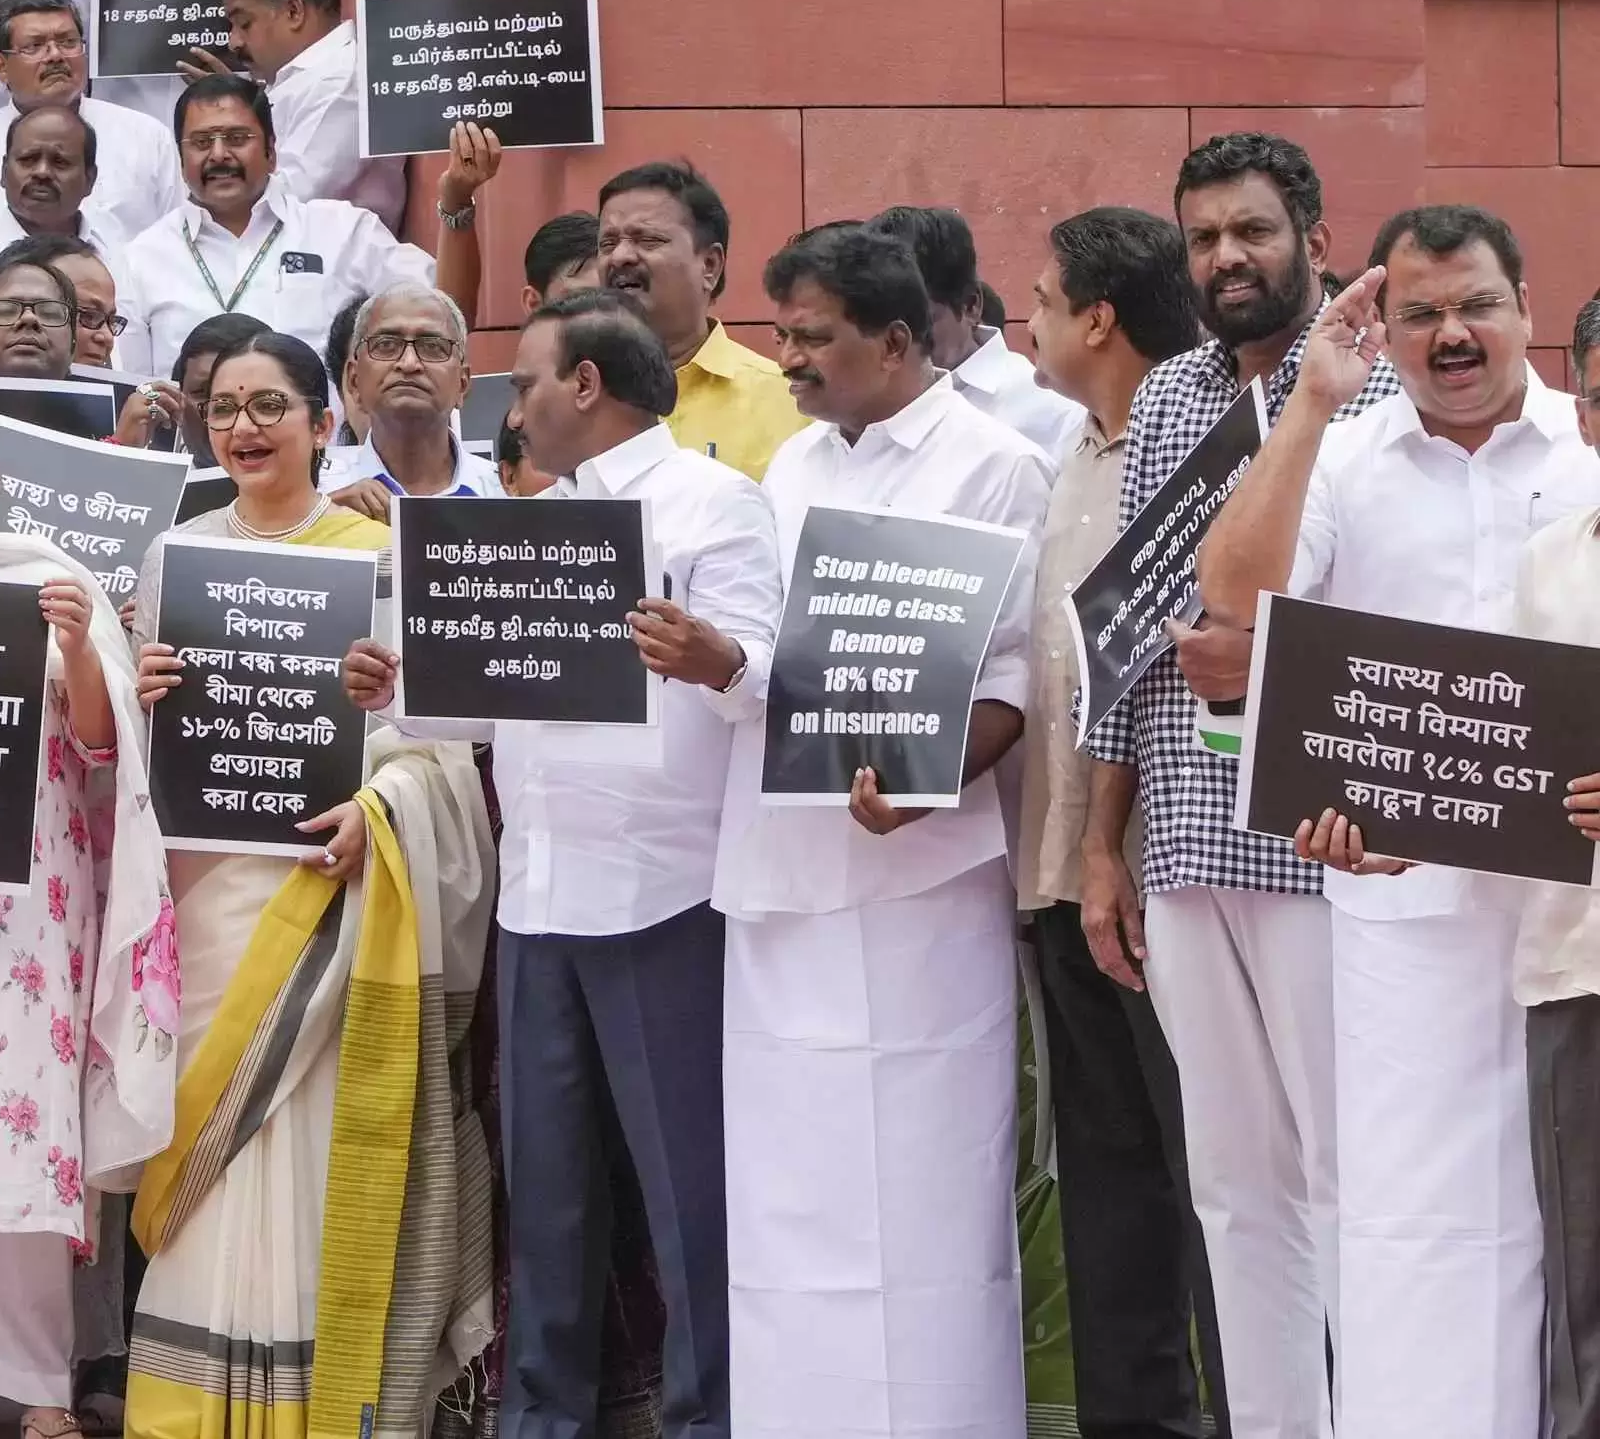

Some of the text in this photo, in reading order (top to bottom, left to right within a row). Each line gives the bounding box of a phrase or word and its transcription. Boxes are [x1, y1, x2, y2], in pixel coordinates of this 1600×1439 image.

[389, 11, 563, 41] மருத்துவம் மற்றும்
[391, 39, 562, 67] உயிர்க்காப்பீட்டில்
[371, 69, 586, 96] 18 சதவீத ஜி.எஸ்.டி-யை
[441, 98, 513, 119] அகற்று
[426, 538, 617, 567] மருத்துவம் மற்றும்
[812, 554, 984, 597] Stop bleeding
[429, 576, 616, 605] உயிர்க்காப்பீட்டில்
[807, 592, 967, 625] middle class.
[223, 607, 308, 641] বিপাকে
[407, 616, 426, 635] 18
[430, 614, 496, 641] சதவீத
[828, 628, 926, 656] Remove
[238, 650, 279, 674] বন্ধ
[484, 653, 561, 681] அகற்று
[205, 675, 317, 710] বীমা থেকে
[823, 666, 920, 693] 18% GST
[1347, 656, 1526, 708] स्वास्थ्य आणि
[245, 711, 337, 746] জিএসটি
[790, 707, 941, 735] on insurance
[1333, 689, 1532, 751] जीवन विम्यावर
[209, 753, 305, 779] প্রত্যাহার
[1302, 730, 1554, 794] लावलेला १८% GST
[202, 788, 306, 815] করা হোক
[1343, 779, 1503, 828] काढून टाका
